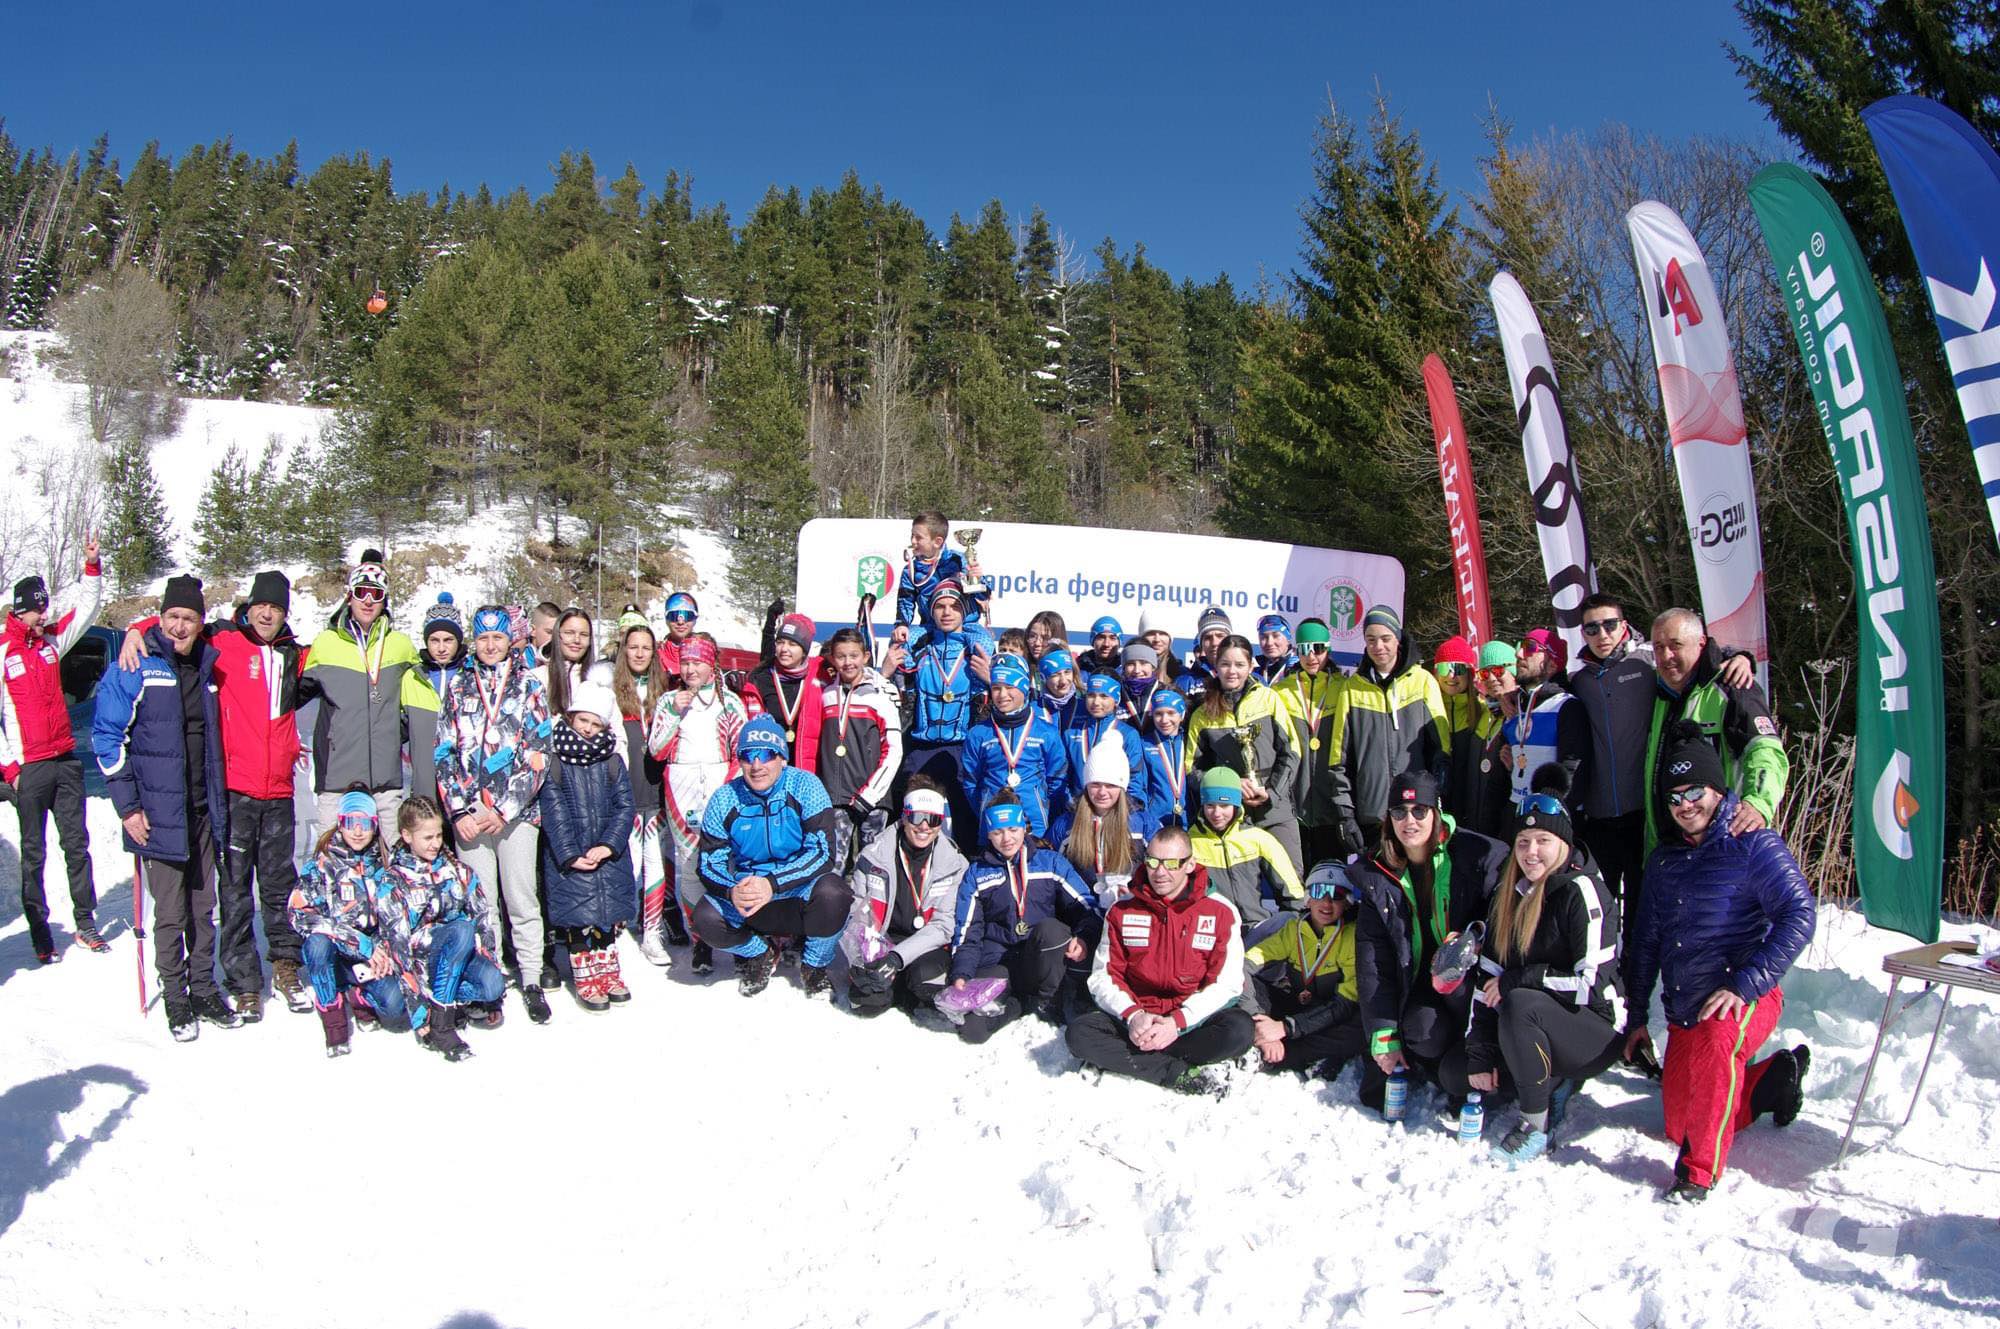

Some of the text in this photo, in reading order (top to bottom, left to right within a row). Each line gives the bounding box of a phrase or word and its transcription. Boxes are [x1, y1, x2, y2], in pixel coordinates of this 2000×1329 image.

[985, 570, 1299, 613] арска федерация по ски
